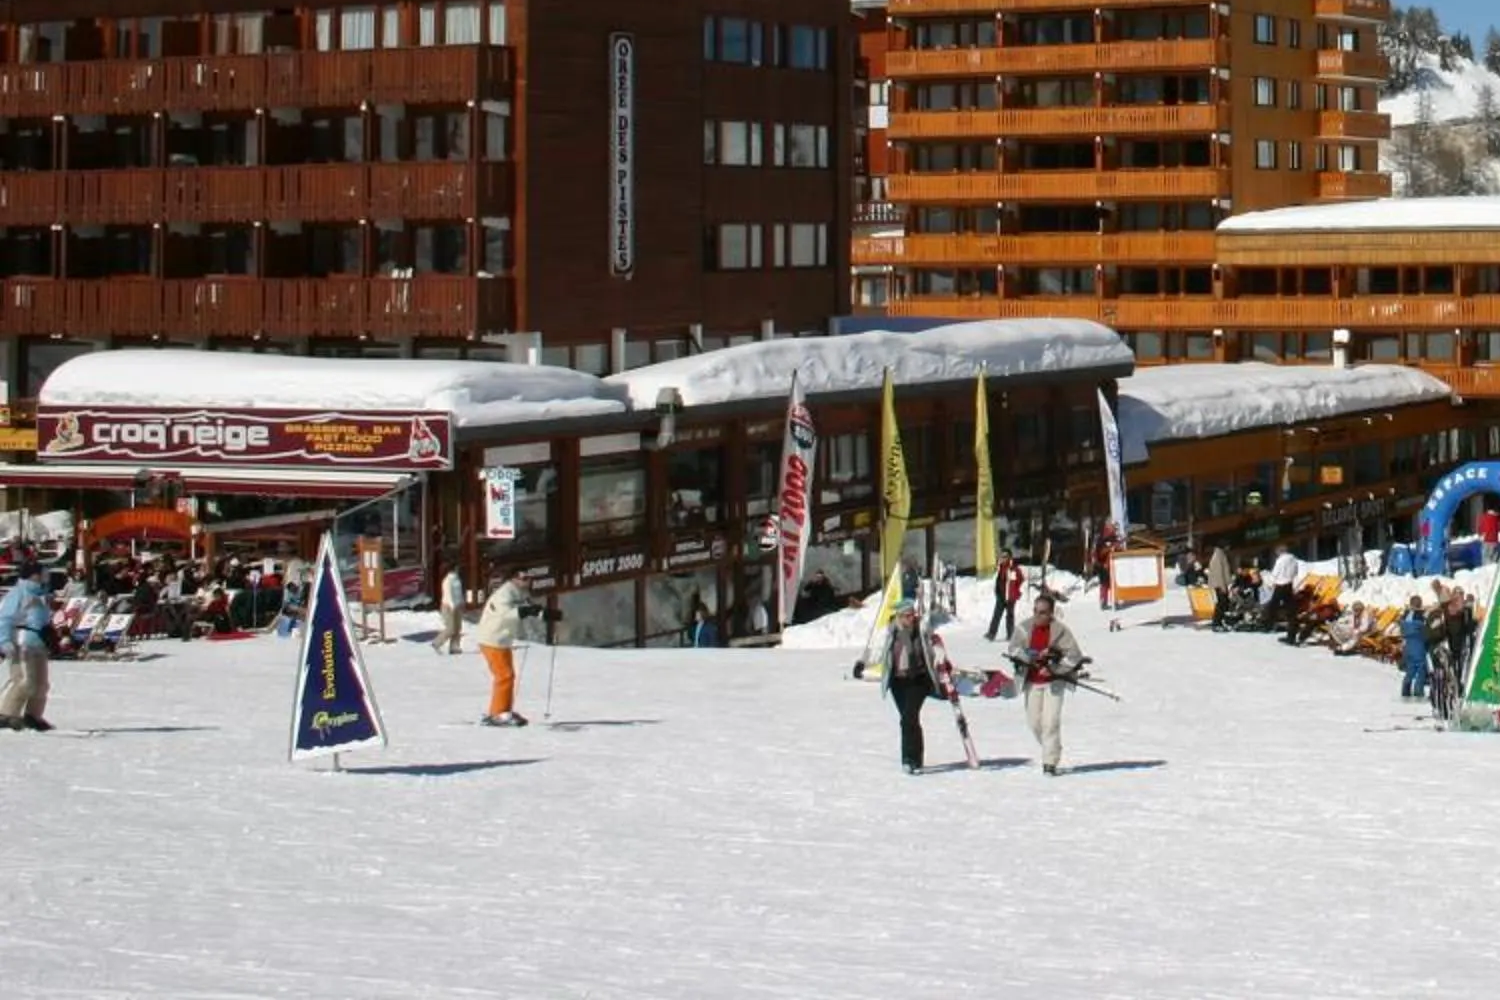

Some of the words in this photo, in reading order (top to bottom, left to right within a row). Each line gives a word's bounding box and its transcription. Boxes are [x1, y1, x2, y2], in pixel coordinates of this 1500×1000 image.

[617, 115, 629, 164] DES
[617, 169, 629, 268] PISTES
[305, 433, 339, 442] FAST
[345, 435, 383, 443] FOOD
[314, 443, 375, 453] PIZZERIA
[373, 425, 401, 434] BAR
[781, 453, 808, 529] 2000
[1426, 467, 1489, 510] ESPACE
[581, 557, 617, 578] SPORT
[617, 553, 644, 572] 2000
[322, 630, 336, 699] Evolution
